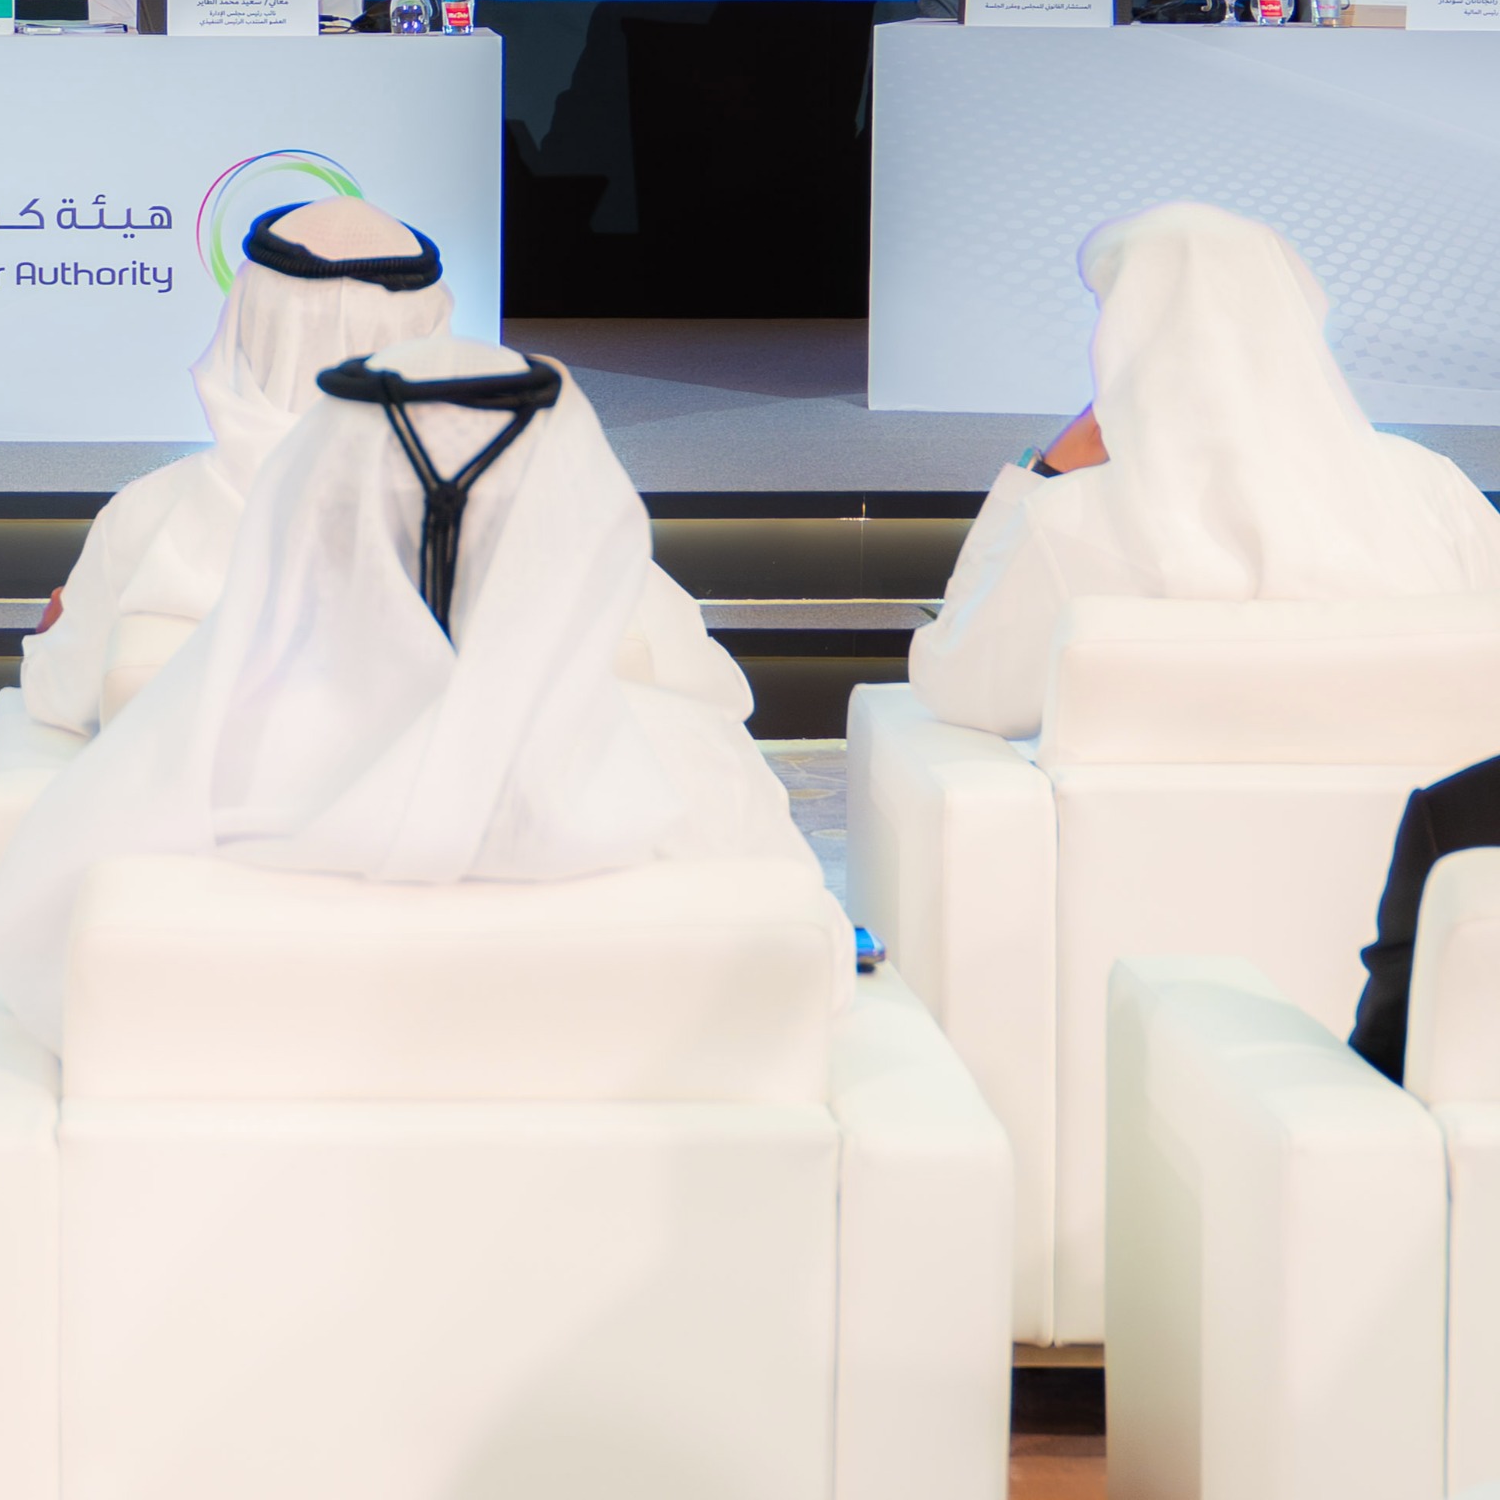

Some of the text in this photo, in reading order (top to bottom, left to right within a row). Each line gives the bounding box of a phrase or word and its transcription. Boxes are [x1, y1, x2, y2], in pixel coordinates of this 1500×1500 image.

[241, 0, 262, 7] سعيد
[56, 194, 173, 239] هيئة
[16, 260, 173, 294] Authority
